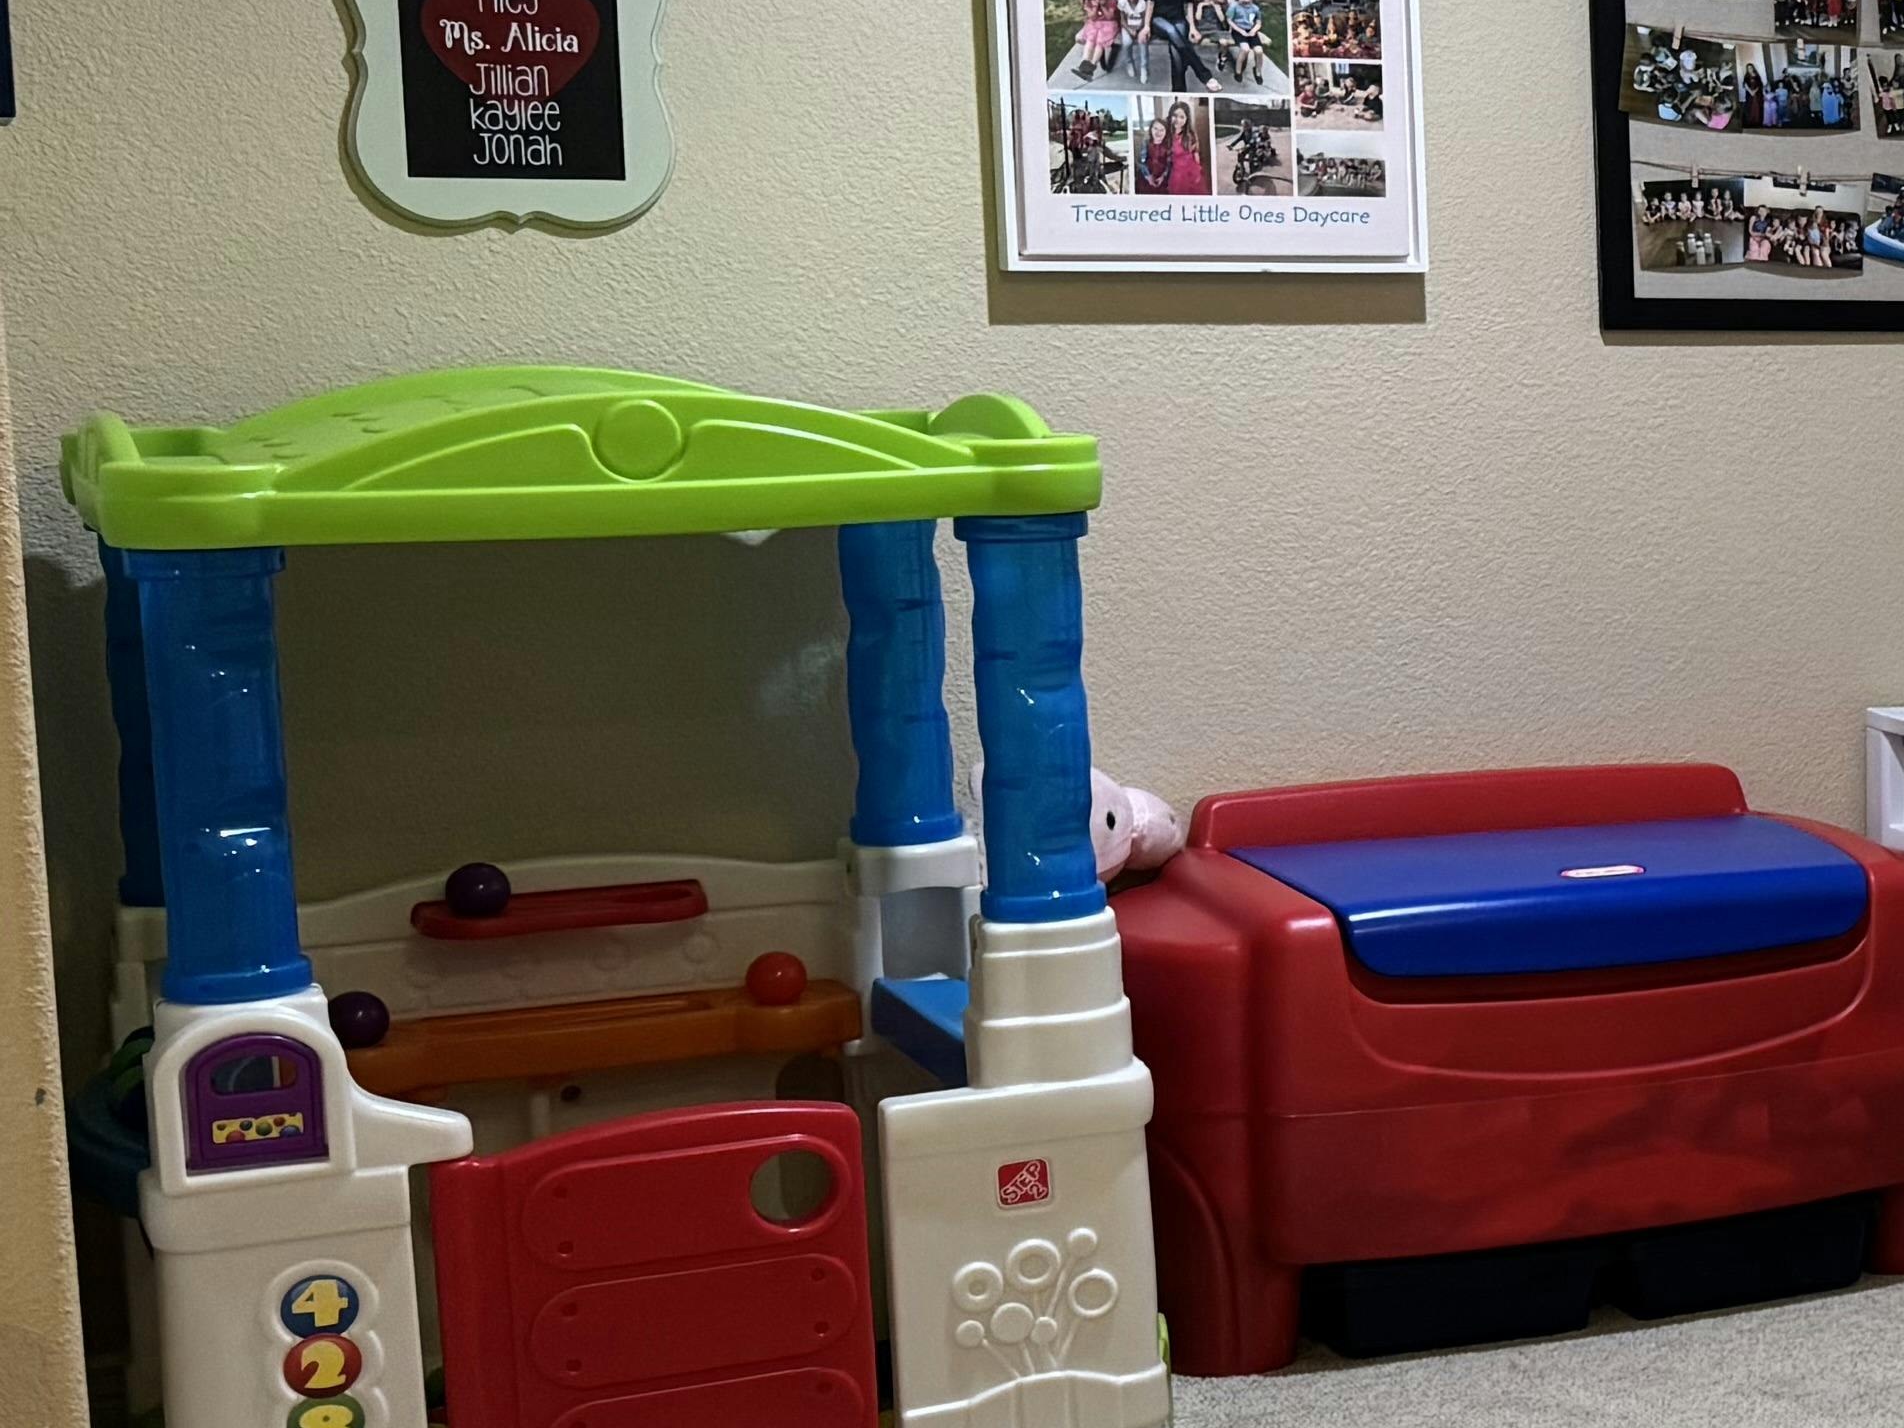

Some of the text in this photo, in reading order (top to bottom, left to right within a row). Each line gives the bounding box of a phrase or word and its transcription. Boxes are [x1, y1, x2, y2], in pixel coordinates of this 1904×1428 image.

[439, 18, 579, 56] Ms. Alicia
[468, 63, 550, 98] Jillian
[472, 132, 563, 167] Jonah
[1069, 203, 1371, 229] Treasured Little Ones Daycare
[291, 1279, 349, 1328] 4
[301, 1339, 347, 1390] 2
